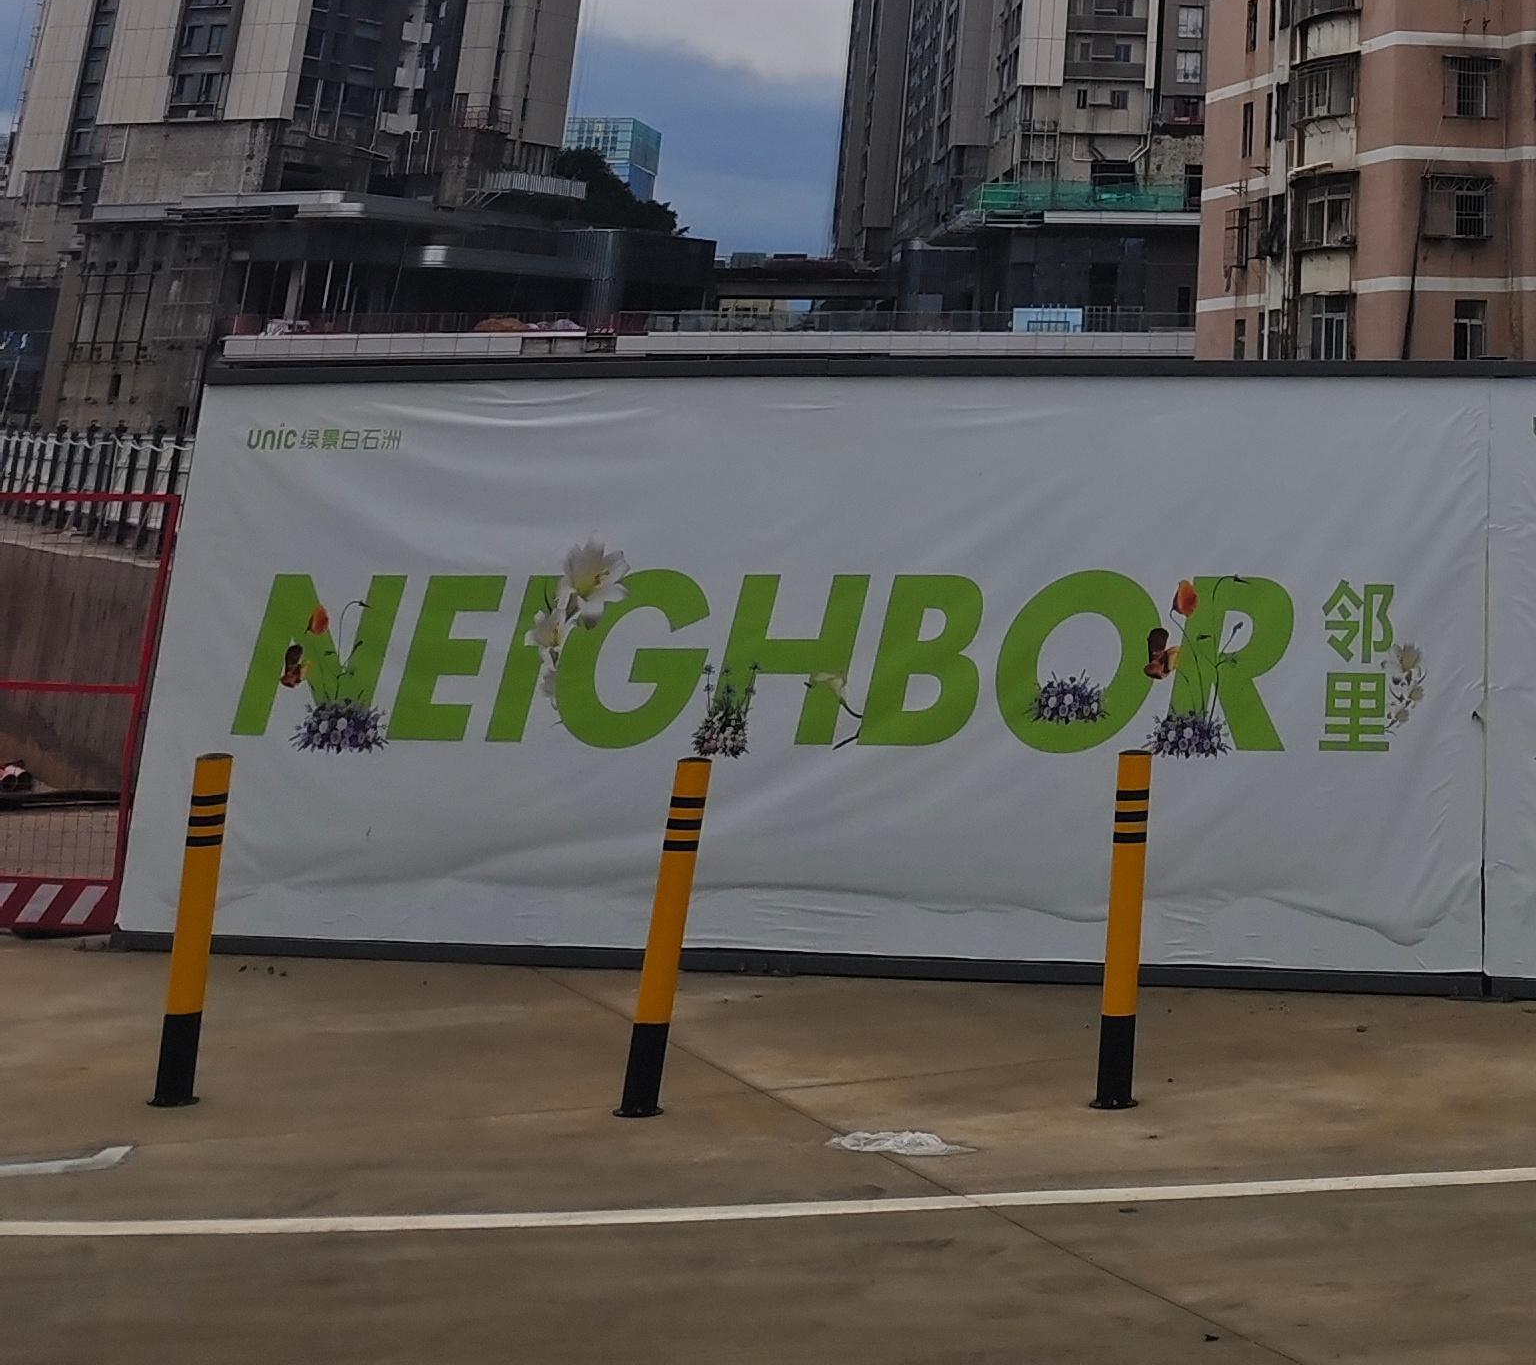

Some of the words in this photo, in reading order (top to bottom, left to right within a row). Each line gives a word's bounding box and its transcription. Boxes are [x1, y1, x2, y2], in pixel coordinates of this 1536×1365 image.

[246, 423, 297, 450] unic
[299, 428, 402, 450] 绿景白石洲
[230, 569, 1294, 754] NEIGHBOR
[1318, 579, 1394, 752] 邻里
